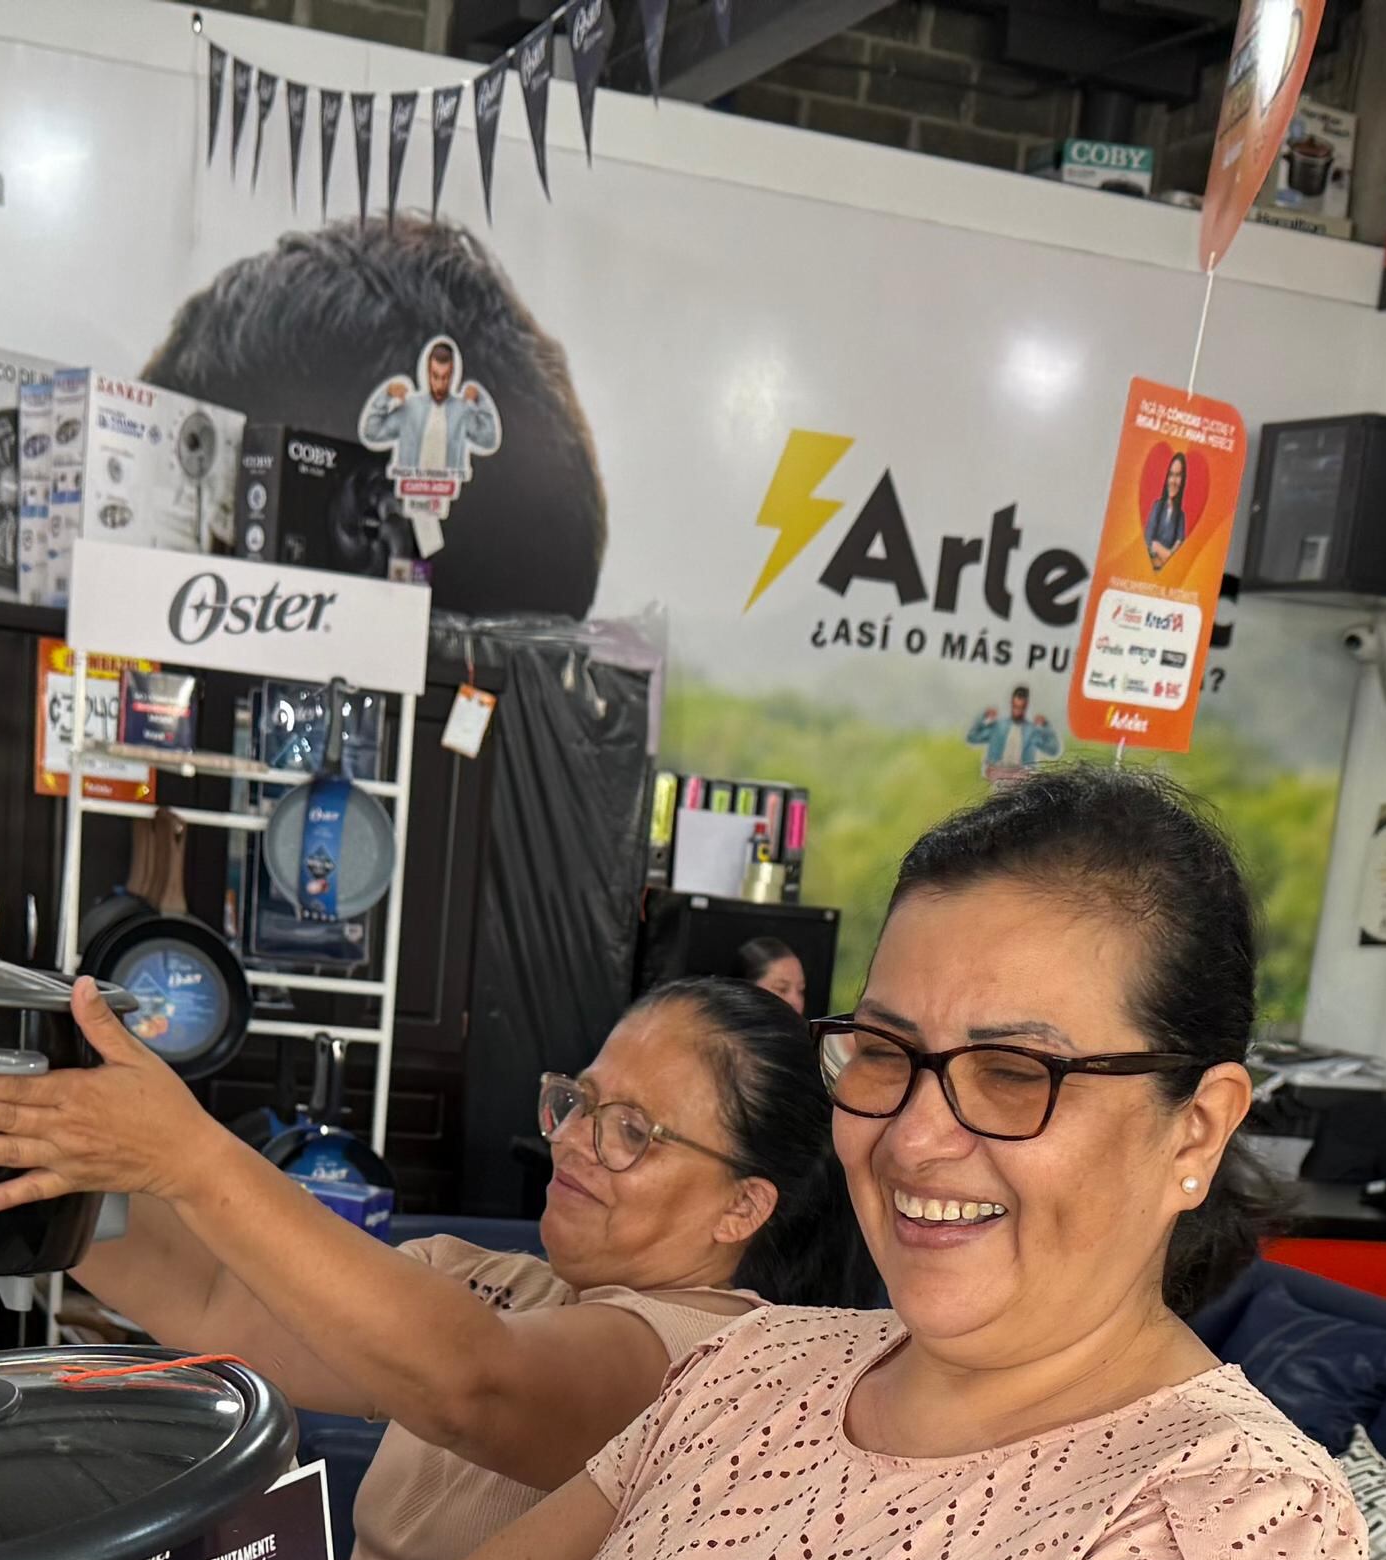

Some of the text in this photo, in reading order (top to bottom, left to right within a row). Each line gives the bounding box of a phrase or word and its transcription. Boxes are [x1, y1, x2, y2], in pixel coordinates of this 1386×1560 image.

[1070, 141, 1149, 170] COBY
[287, 439, 338, 468] COBY
[167, 571, 340, 646] Oster
[811, 614, 1013, 668] ¿ASÍ O MÁS
